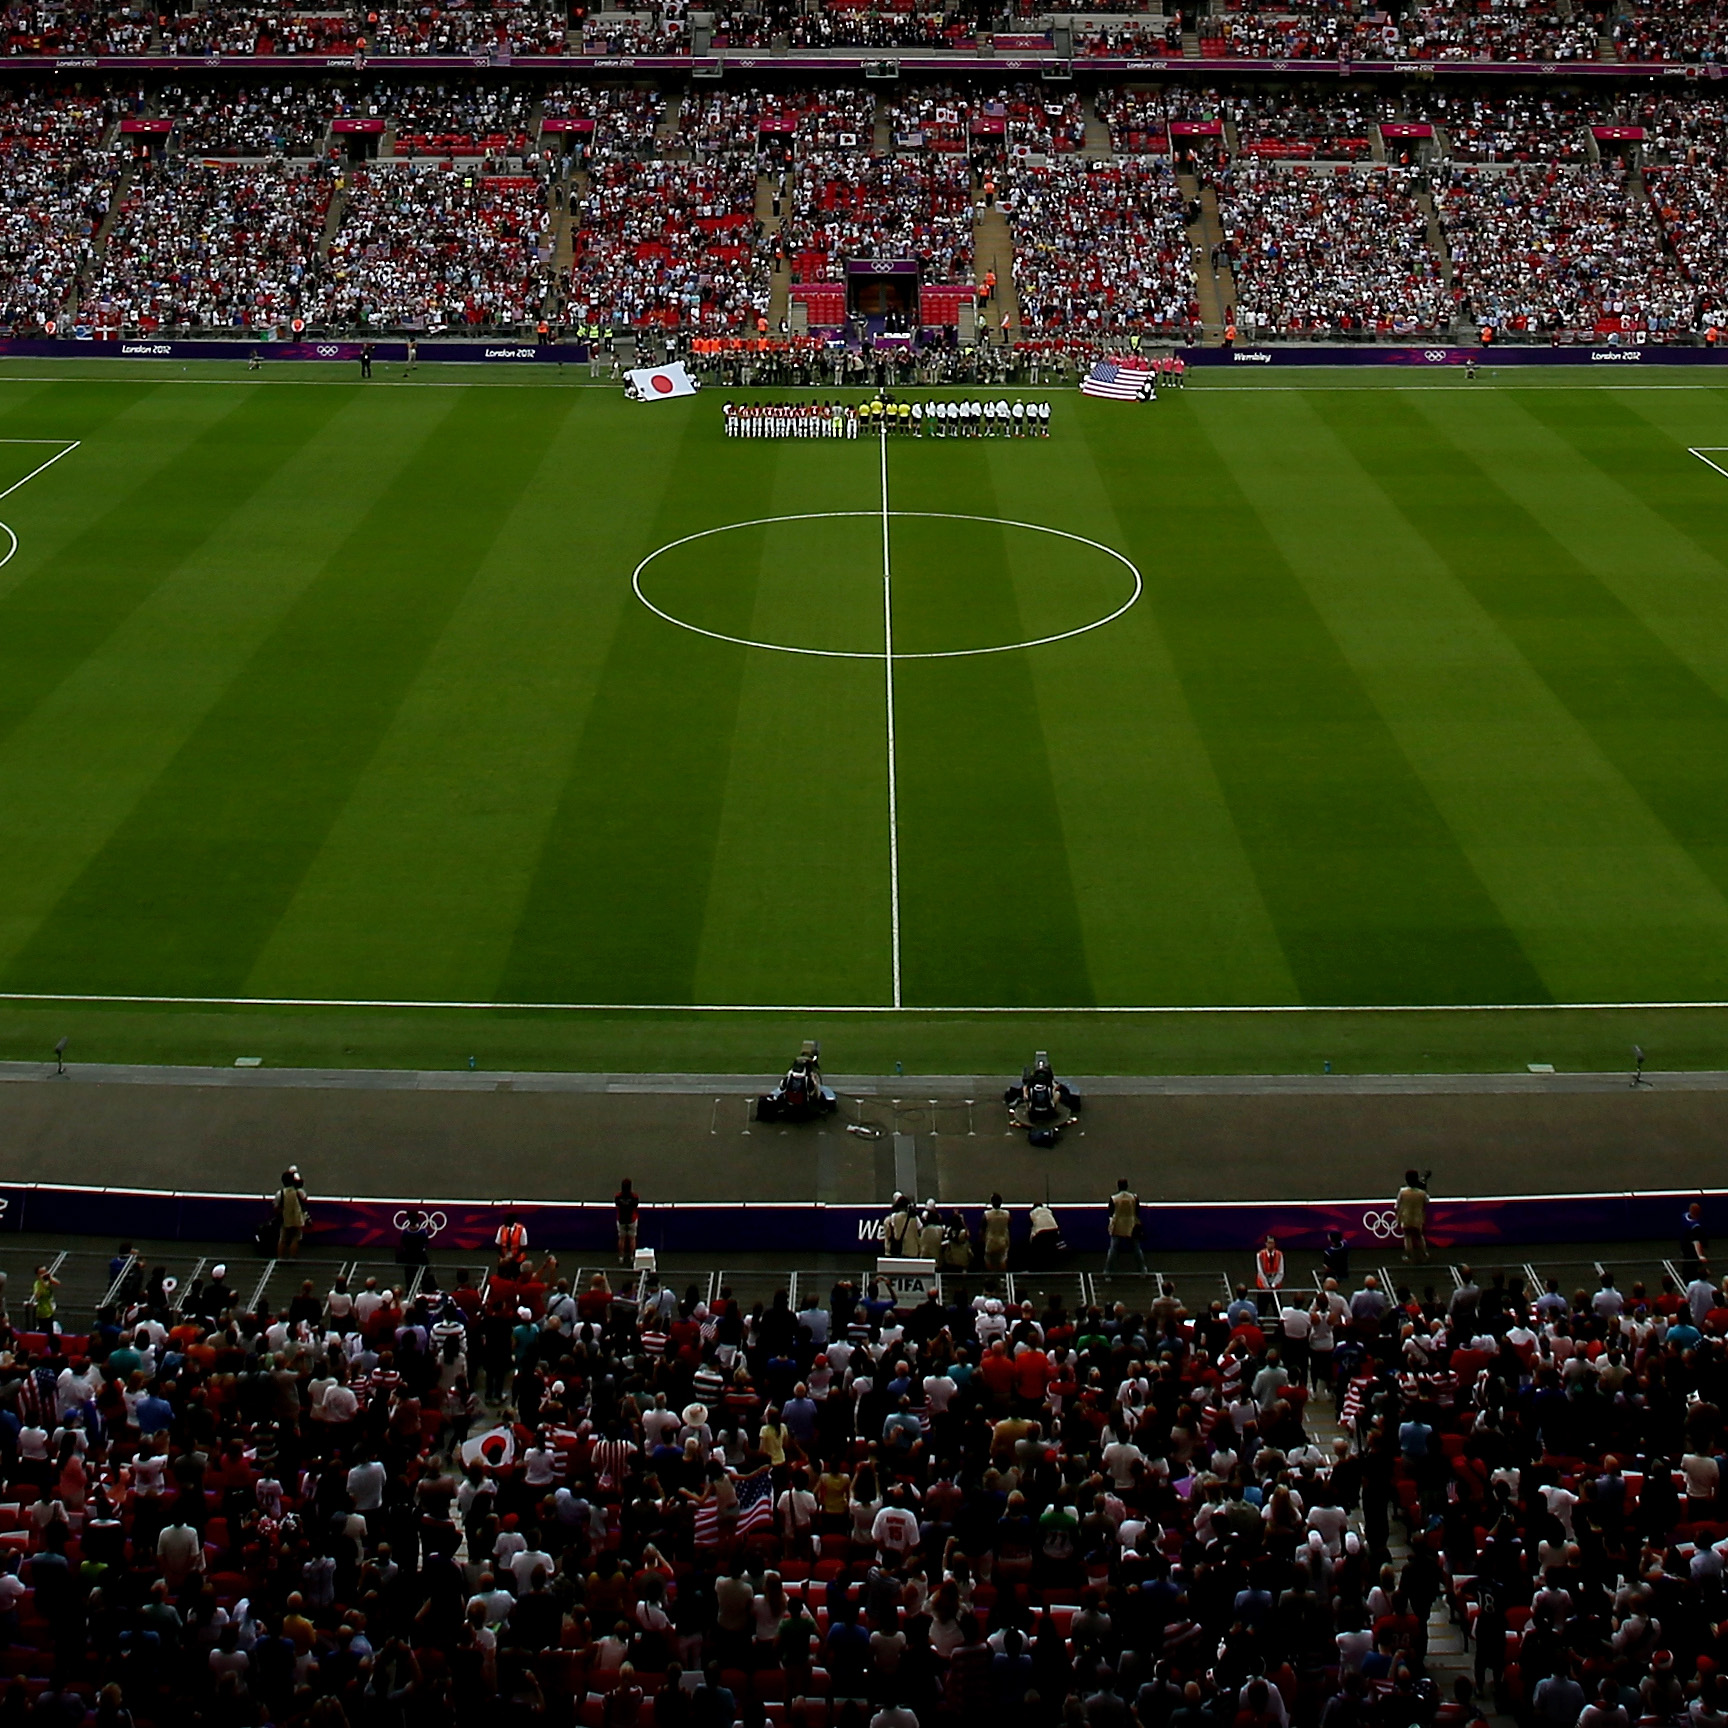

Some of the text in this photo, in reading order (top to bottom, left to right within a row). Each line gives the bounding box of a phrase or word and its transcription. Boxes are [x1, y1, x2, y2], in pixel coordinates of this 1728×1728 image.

[122, 345, 152, 354] London
[485, 348, 515, 358] London
[1233, 352, 1272, 363] Wembley
[1591, 351, 1622, 360] London
